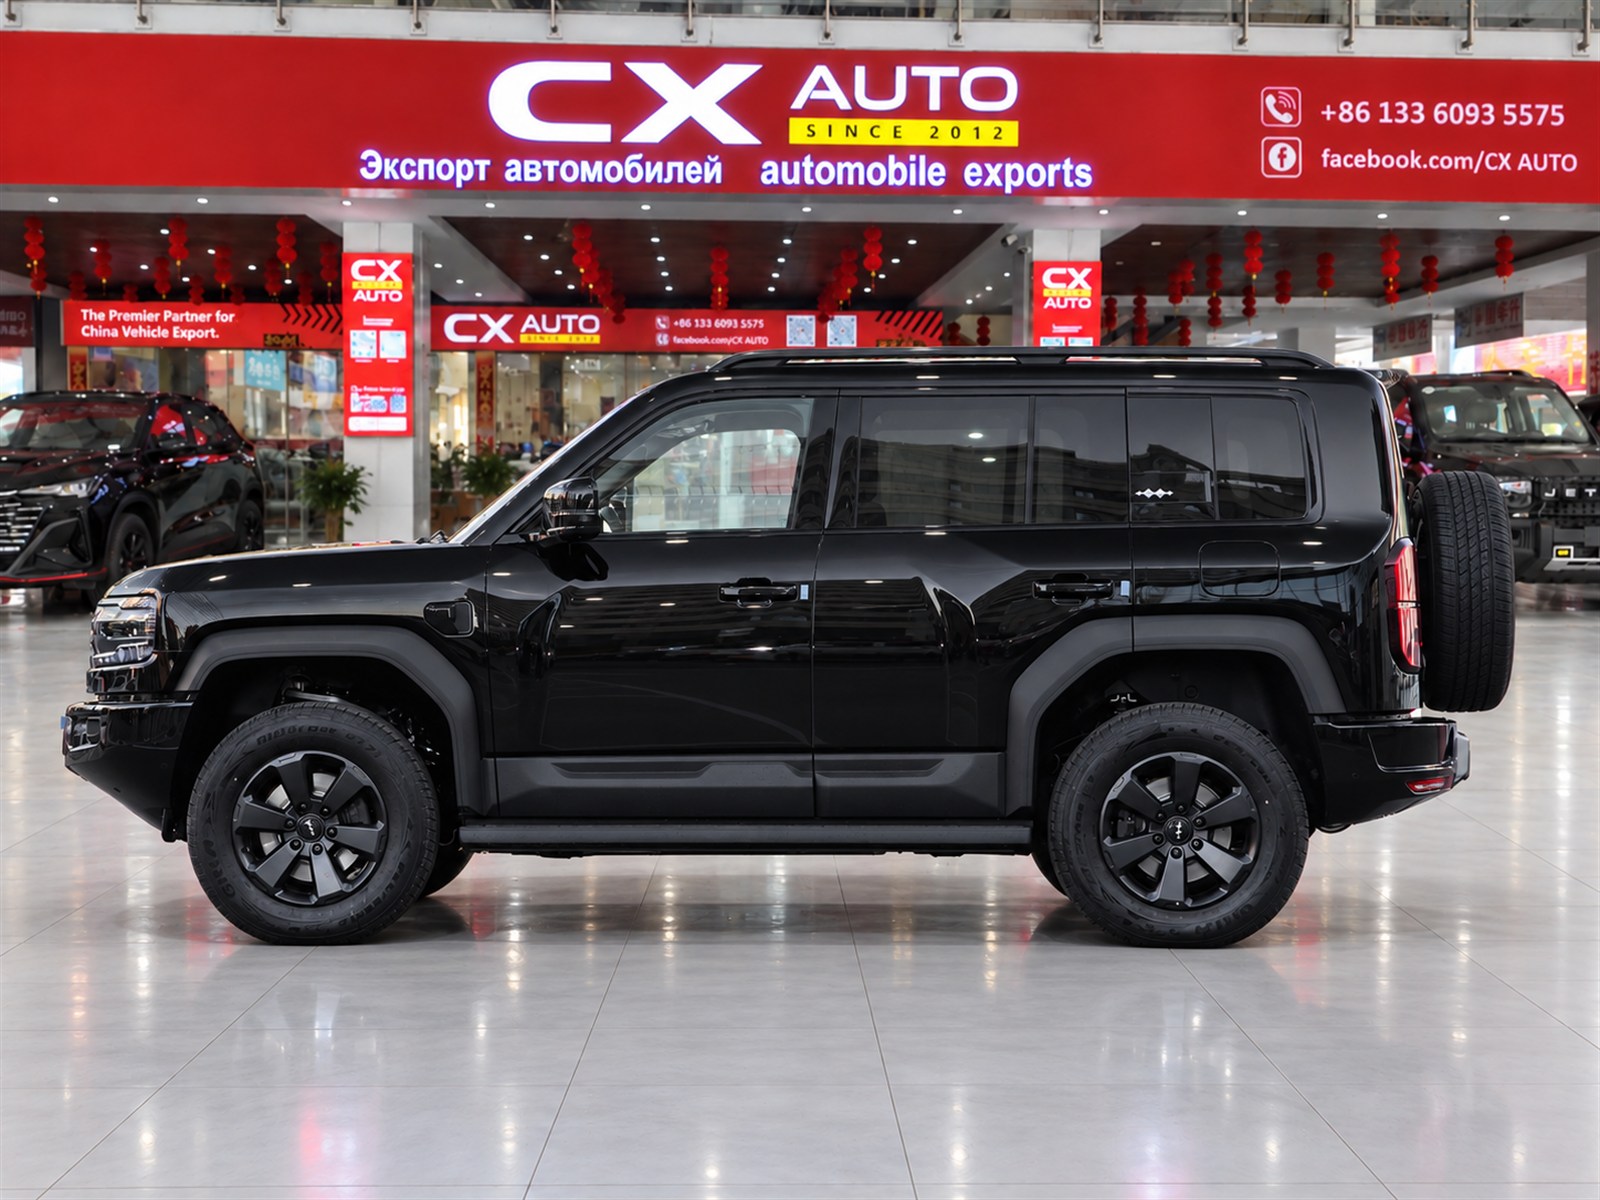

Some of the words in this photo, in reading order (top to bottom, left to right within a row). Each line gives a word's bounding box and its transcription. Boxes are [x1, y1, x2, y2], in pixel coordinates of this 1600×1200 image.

[488, 60, 762, 145] CX
[790, 65, 1018, 111] AUTO
[1321, 101, 1370, 124] +86
[1379, 101, 1425, 124] 133
[1433, 102, 1496, 126] 6093
[1503, 103, 1565, 126] 5575
[806, 124, 902, 139] SINCE
[929, 125, 1003, 141] 2012
[359, 149, 491, 188] Экспорт
[504, 153, 723, 184] автомобилей
[1321, 149, 1511, 174] facebook.com/CX
[1517, 153, 1578, 173] AUTO
[760, 154, 946, 186] automobile
[963, 158, 1093, 194] exports
[350, 259, 402, 282] CX
[1042, 267, 1092, 290] CX
[353, 290, 403, 302] AUTO
[1043, 297, 1092, 309] AUTO
[81, 309, 105, 321] The
[109, 310, 160, 322] Premier
[163, 310, 212, 322] Partner
[215, 310, 235, 322] for
[694, 318, 712, 328] 133
[714, 319, 738, 329] 6093
[81, 325, 119, 337] China
[122, 326, 169, 338] Vehicle
[172, 326, 220, 341] Export.
[443, 313, 515, 343] CX
[520, 314, 600, 333] AUTO
[745, 336, 769, 345] AUTO
